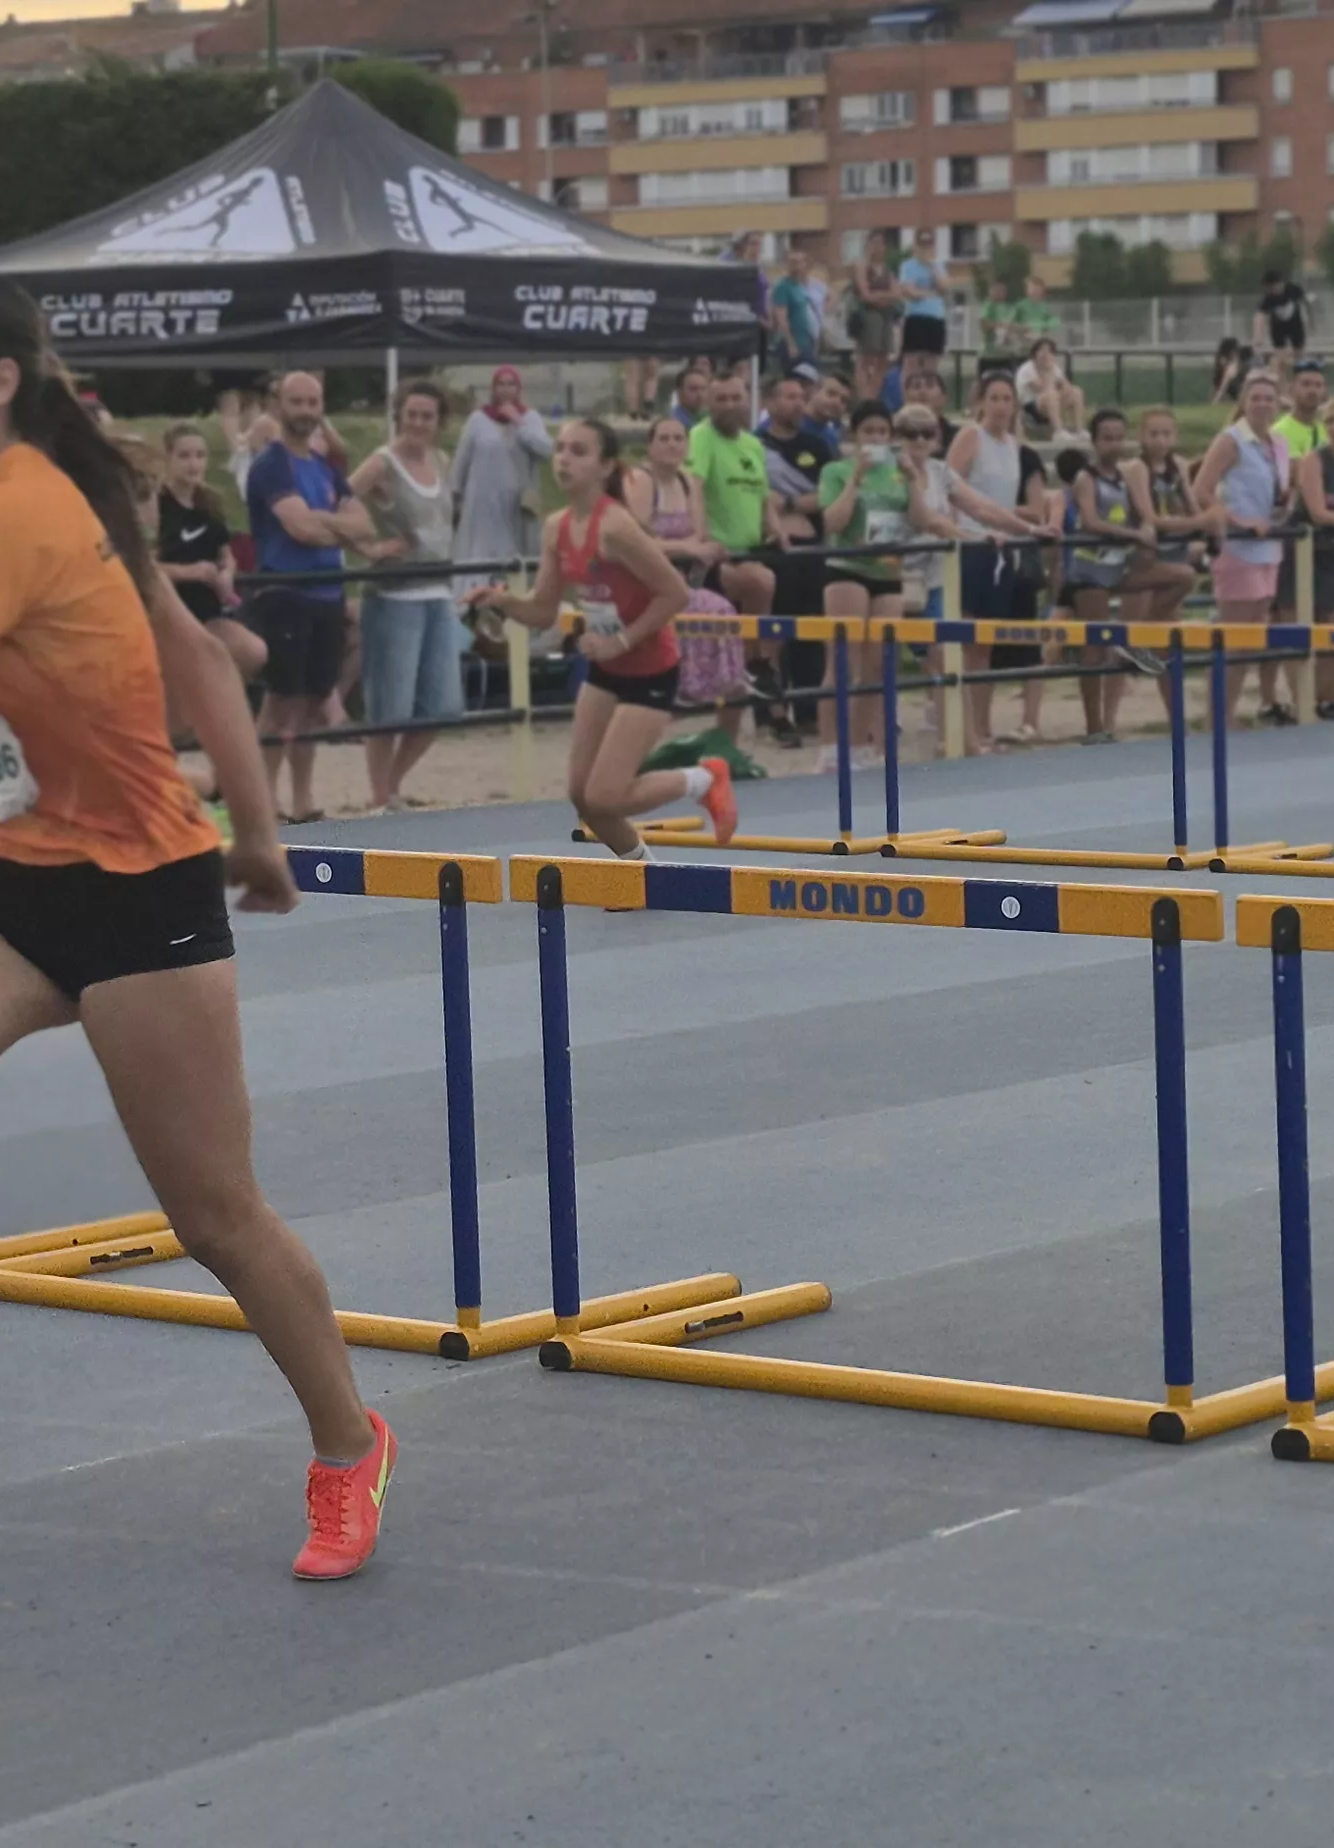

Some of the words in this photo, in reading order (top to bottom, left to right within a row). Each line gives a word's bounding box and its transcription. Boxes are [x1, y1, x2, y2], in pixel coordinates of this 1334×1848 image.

[41, 293, 103, 310] CLUB
[514, 285, 563, 301] CLUB
[49, 308, 221, 339] CUARTE
[523, 304, 649, 334] CUARTE
[769, 879, 926, 918] MONDO
